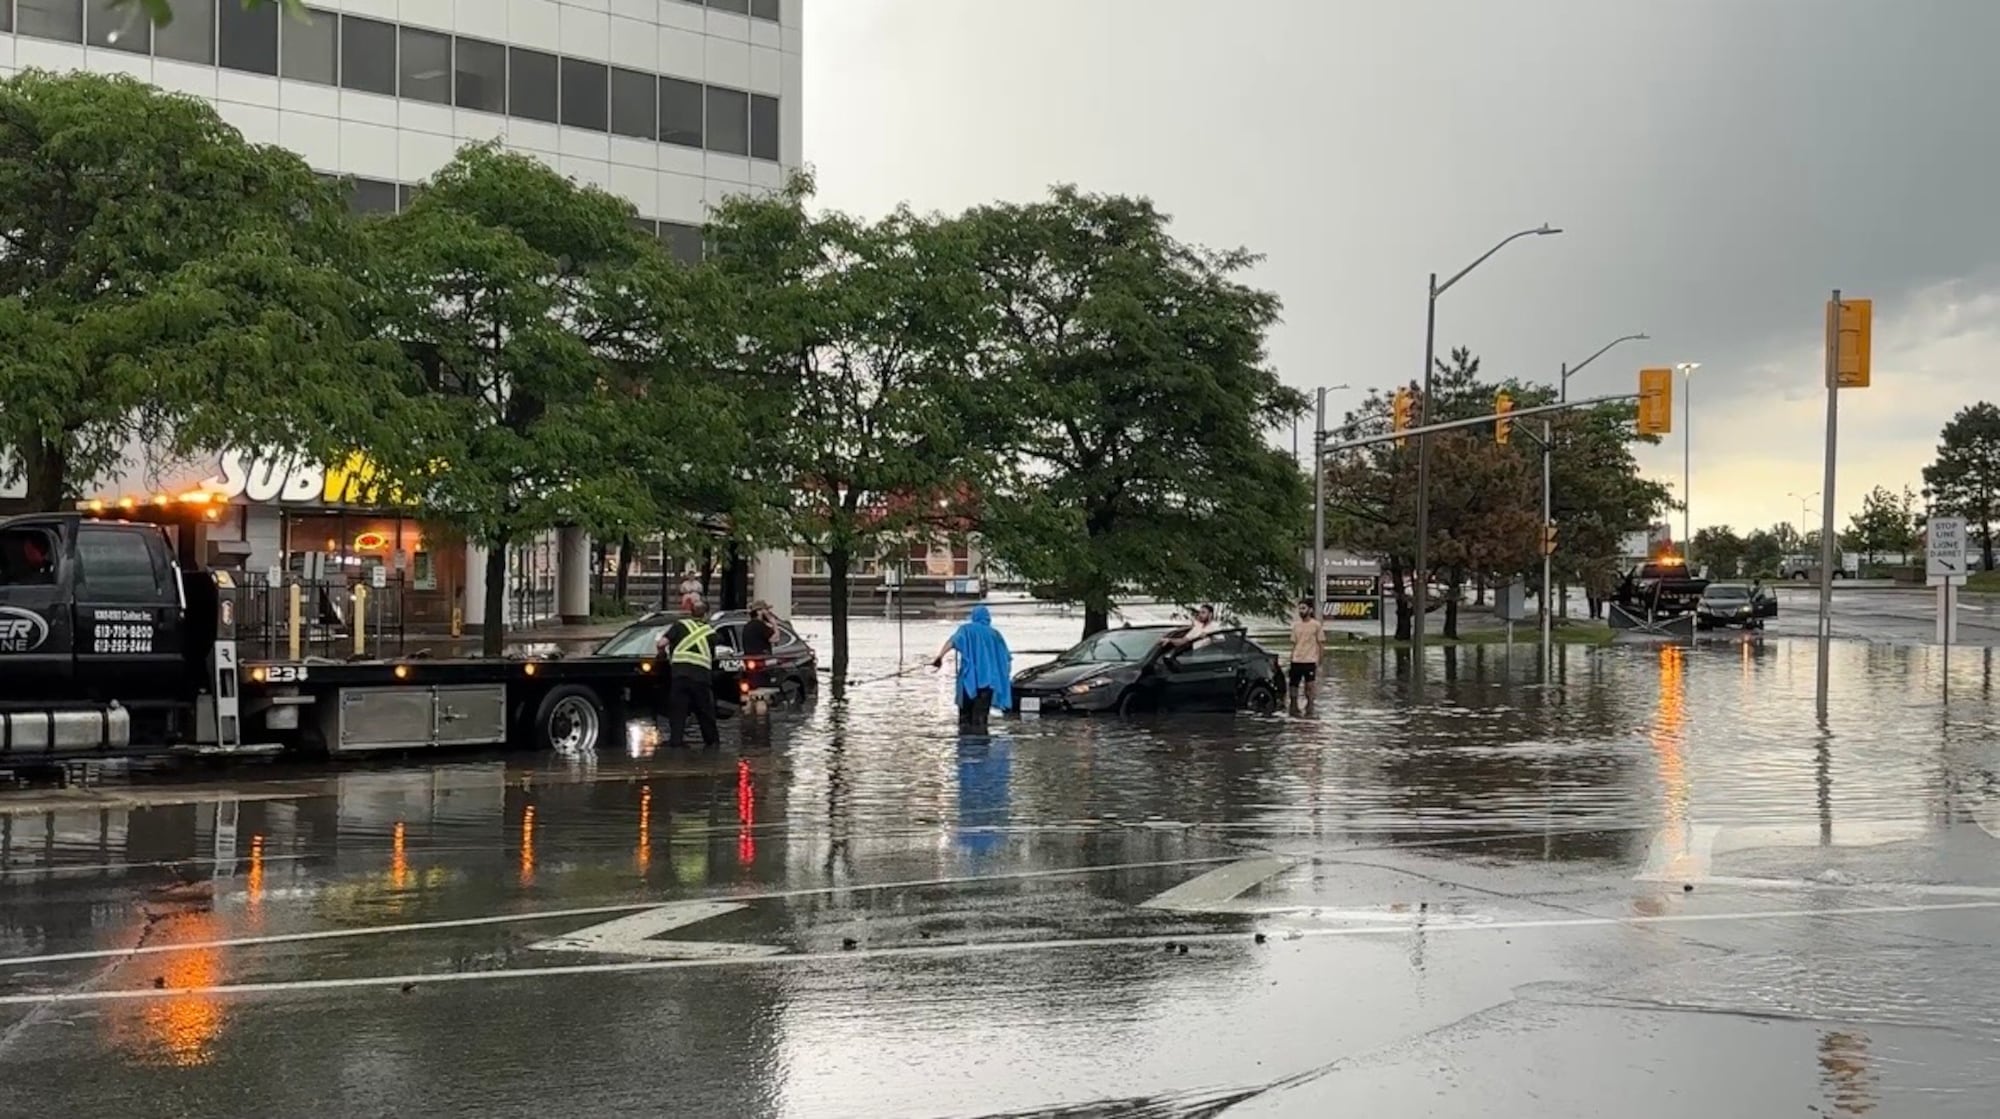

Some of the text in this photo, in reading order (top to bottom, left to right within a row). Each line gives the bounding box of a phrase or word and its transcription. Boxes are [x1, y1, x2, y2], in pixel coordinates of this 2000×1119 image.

[199, 446, 422, 503] SUBW
[1935, 522, 1958, 530] STOP
[1322, 602, 1373, 616] UBWAY
